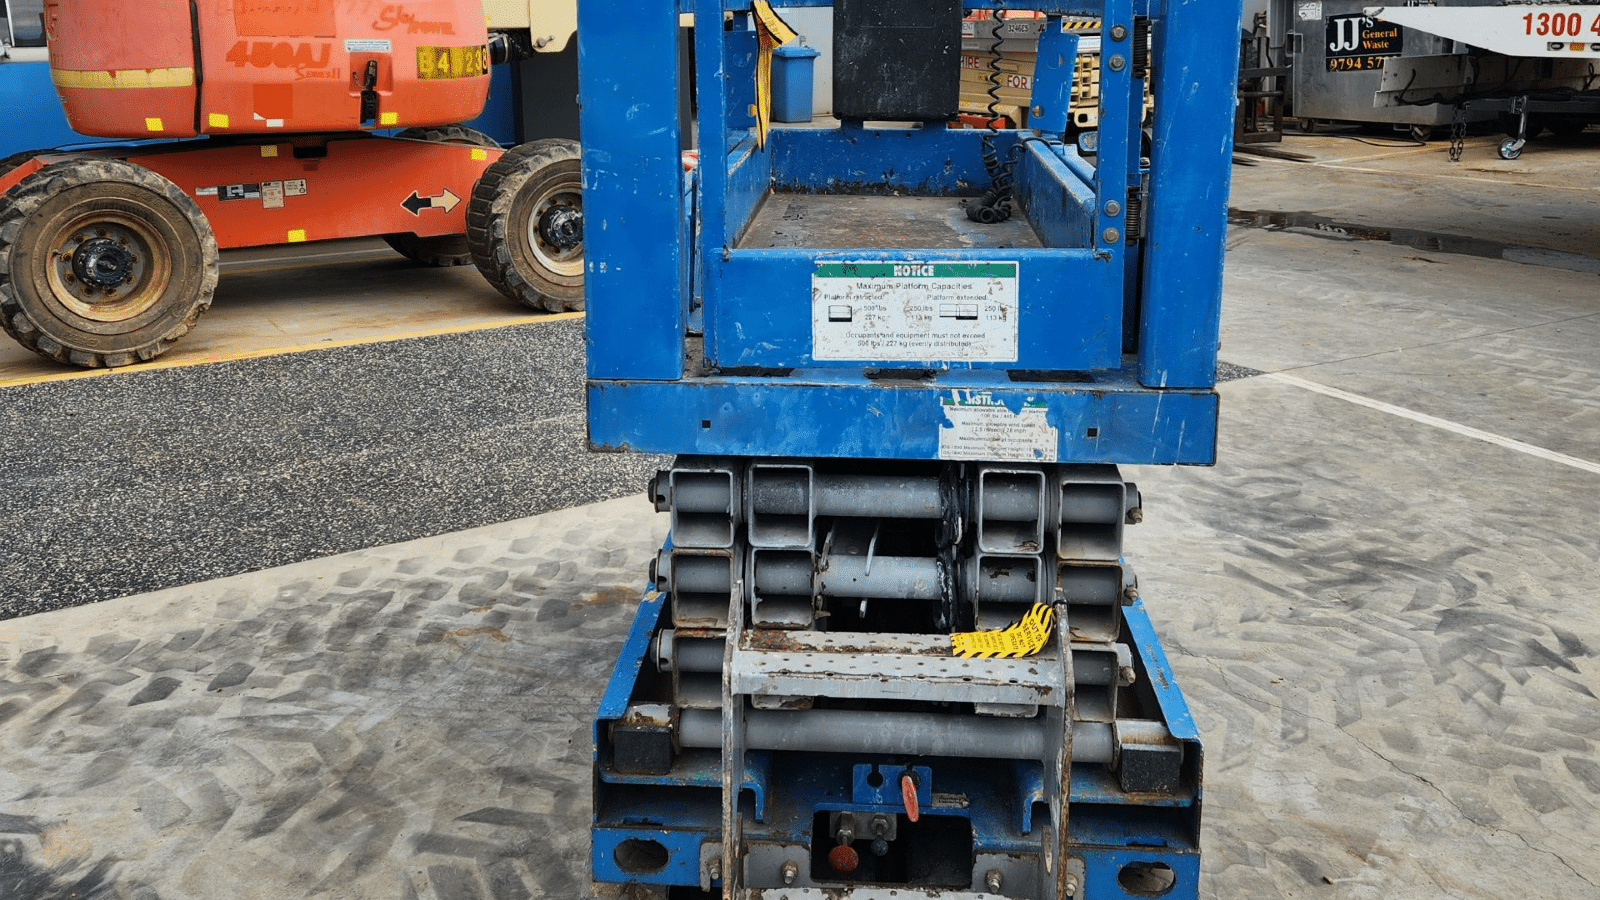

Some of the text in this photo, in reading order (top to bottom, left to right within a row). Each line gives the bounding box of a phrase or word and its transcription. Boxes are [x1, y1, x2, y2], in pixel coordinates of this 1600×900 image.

[1008, 23, 1029, 33] 3246ES
[1522, 12, 1582, 37] 1300
[1362, 27, 1398, 39] General
[1362, 40, 1390, 50] Waste
[1329, 57, 1363, 70] 9794
[1007, 74, 1028, 89] FOR
[893, 264, 935, 277] NOTICE
[856, 282, 973, 292] Maximum Platform Capacities
[1029, 618, 1040, 634] OUT
[1022, 623, 1036, 649] SERVICE
